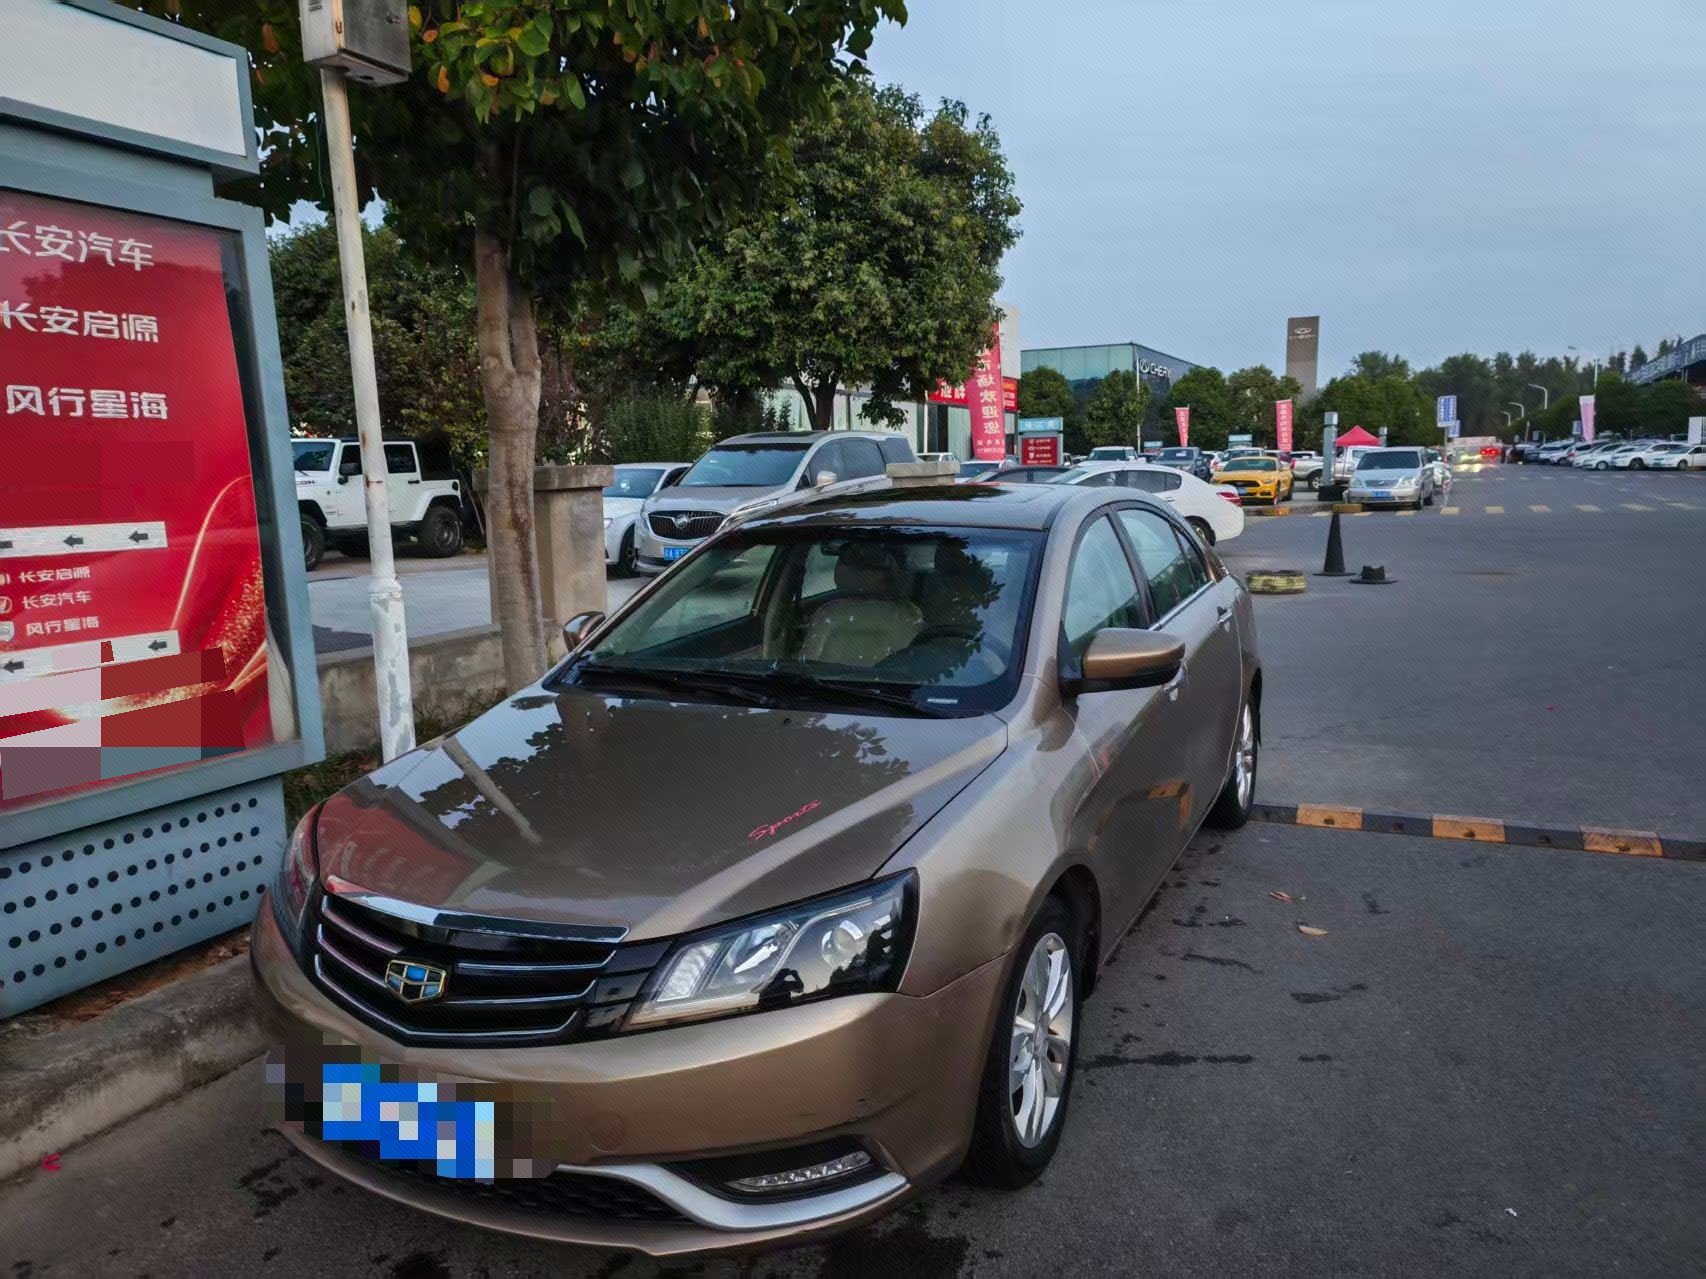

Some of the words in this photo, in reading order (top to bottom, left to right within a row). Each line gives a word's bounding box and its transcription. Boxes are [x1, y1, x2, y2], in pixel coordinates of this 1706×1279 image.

[0, 221, 154, 271] 长安汽车
[0, 301, 159, 343] 长安启源
[6, 384, 169, 420] 风行星海
[19, 566, 90, 583] 长安启源
[22, 590, 92, 609] 长安汽车
[26, 616, 99, 637] 风行星海
[748, 799, 821, 840] Sports
